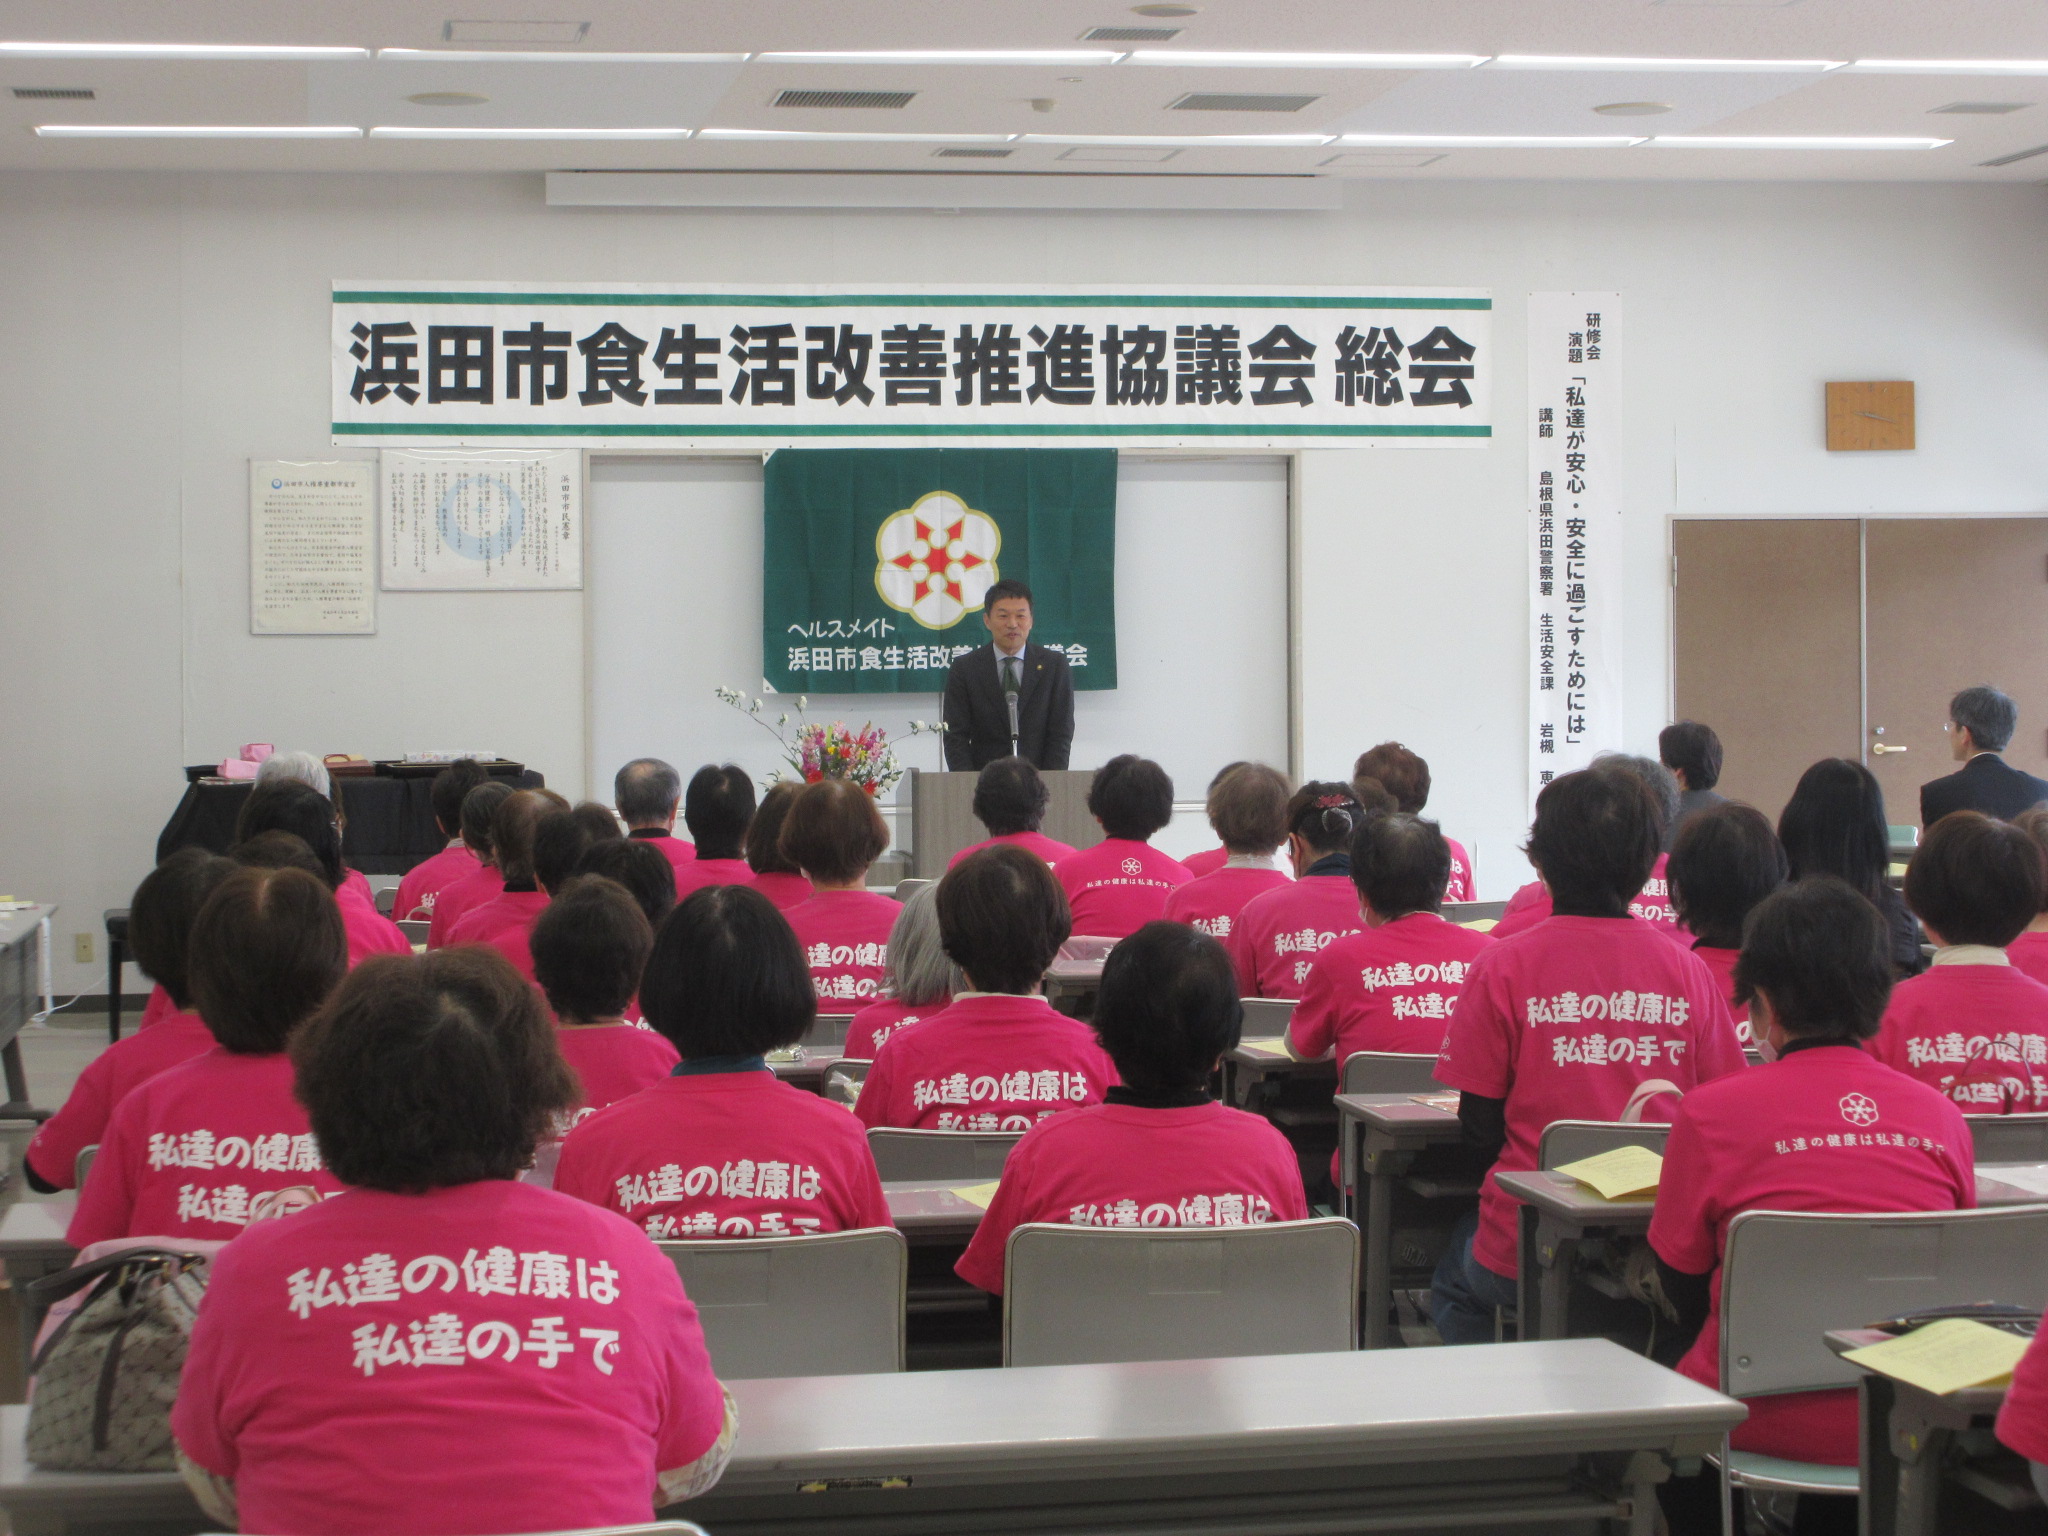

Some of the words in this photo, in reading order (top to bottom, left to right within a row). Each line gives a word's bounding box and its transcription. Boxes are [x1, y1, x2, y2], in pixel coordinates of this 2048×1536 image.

[1568, 332, 1583, 364] 演題
[1586, 313, 1602, 360] 研修会
[1539, 408, 1554, 438] 講師
[561, 475, 571, 540] 浜田市市民憲章
[1539, 471, 1554, 597] 島根県浜田警察署
[788, 618, 895, 638] ヘルスメイト
[1540, 613, 1554, 690] 生活安全課
[1539, 723, 1553, 753] 岩槻
[1361, 960, 1471, 993] 私達の健
[1526, 990, 1690, 1028] 私達の健康は
[1552, 1033, 1687, 1068] 私達の手で
[913, 1070, 1088, 1111] 私達の健康は
[1775, 1133, 1945, 1156] 私達の健康は私達の手で
[615, 1159, 822, 1212] 私達の健康は
[1069, 1193, 1272, 1227] 私達の健康は
[287, 1245, 620, 1319] 私達の健康は
[351, 1313, 620, 1377] 私達の手で
